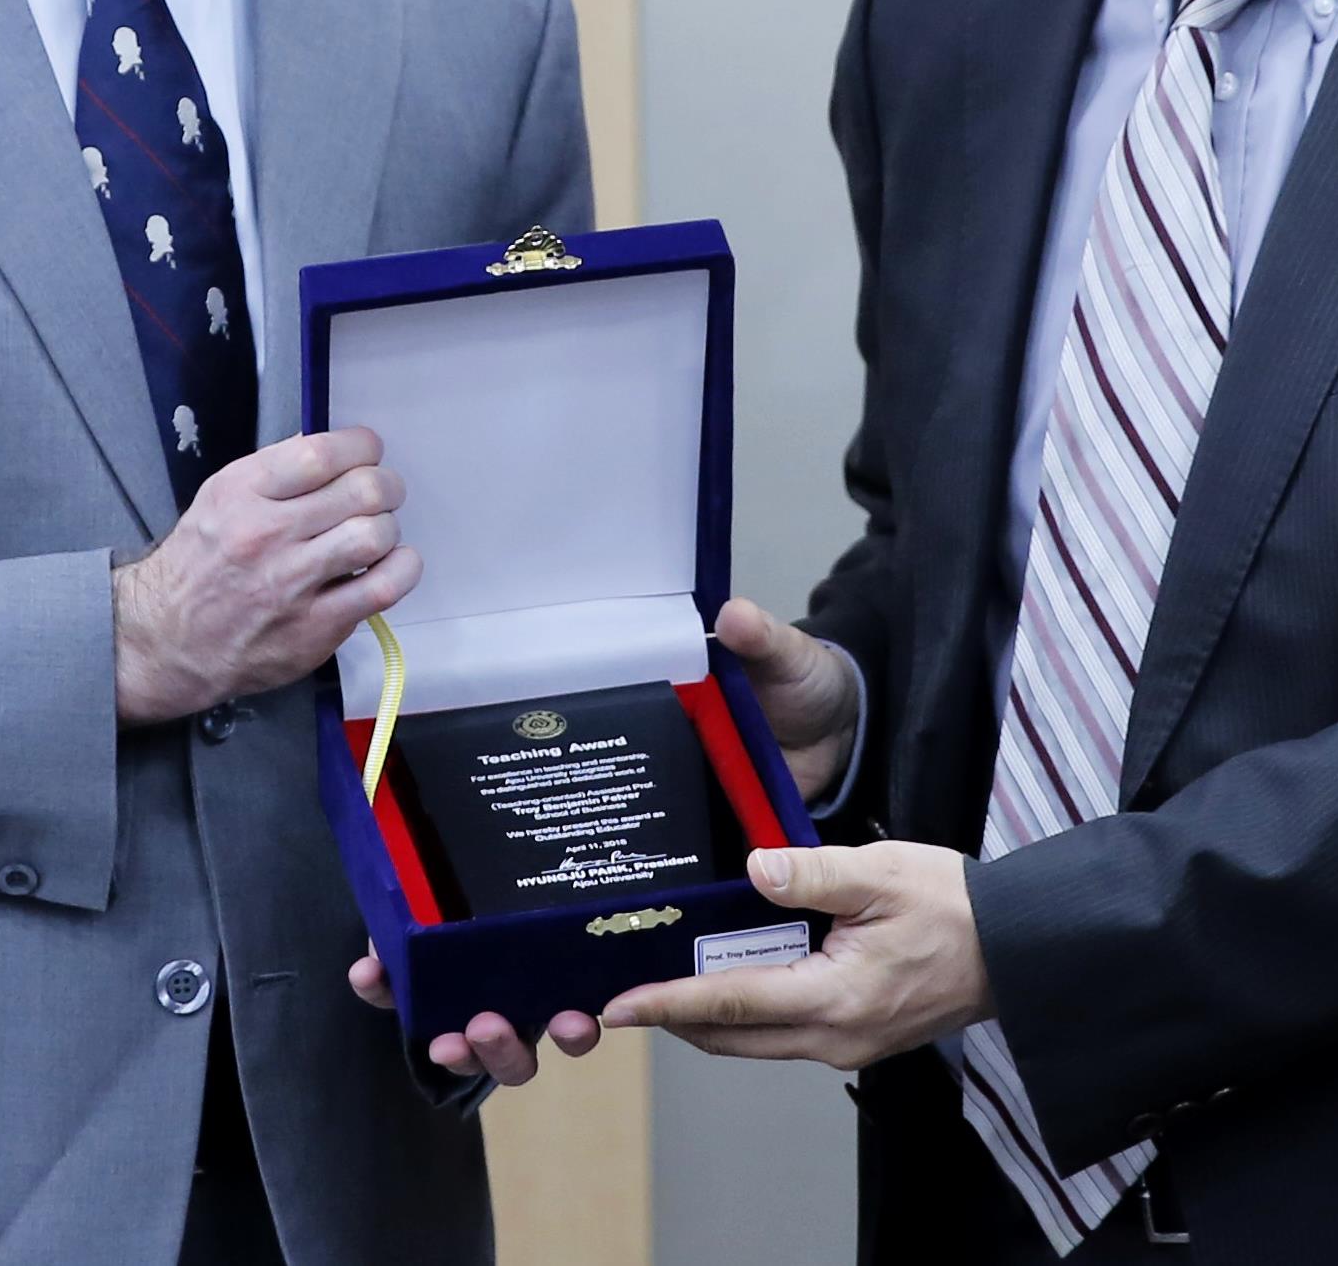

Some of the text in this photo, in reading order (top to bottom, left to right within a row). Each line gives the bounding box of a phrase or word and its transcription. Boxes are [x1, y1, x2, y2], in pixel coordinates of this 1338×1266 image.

[477, 736, 628, 765] Teaching Award
[470, 775, 486, 783] For
[487, 769, 533, 780] excellence
[543, 762, 580, 773] teaching
[581, 758, 598, 767] and
[480, 788, 495, 796] the
[496, 779, 552, 794] distinguished
[553, 777, 570, 786] and
[571, 771, 613, 783] dedicated
[614, 768, 636, 777] work
[505, 764, 616, 785] Ajou University recognizes
[490, 781, 657, 811] (Teaching-oriented) Assistant Prof.
[512, 792, 640, 816] Troy Benjamin Felver
[534, 802, 627, 821] School of Business
[506, 831, 525, 839] We
[526, 825, 560, 836] hereby
[562, 820, 599, 832] present
[620, 812, 651, 823] award
[534, 822, 640, 842] Outstanding Educator
[565, 844, 587, 853] April
[516, 870, 586, 888] HYUNGJU
[588, 864, 633, 878] PARK,
[633, 855, 699, 871] President
[572, 871, 654, 889] Ajou University
[727, 951, 743, 959] Troy
[745, 946, 782, 956] Benjamin
[783, 942, 807, 950] Felver
